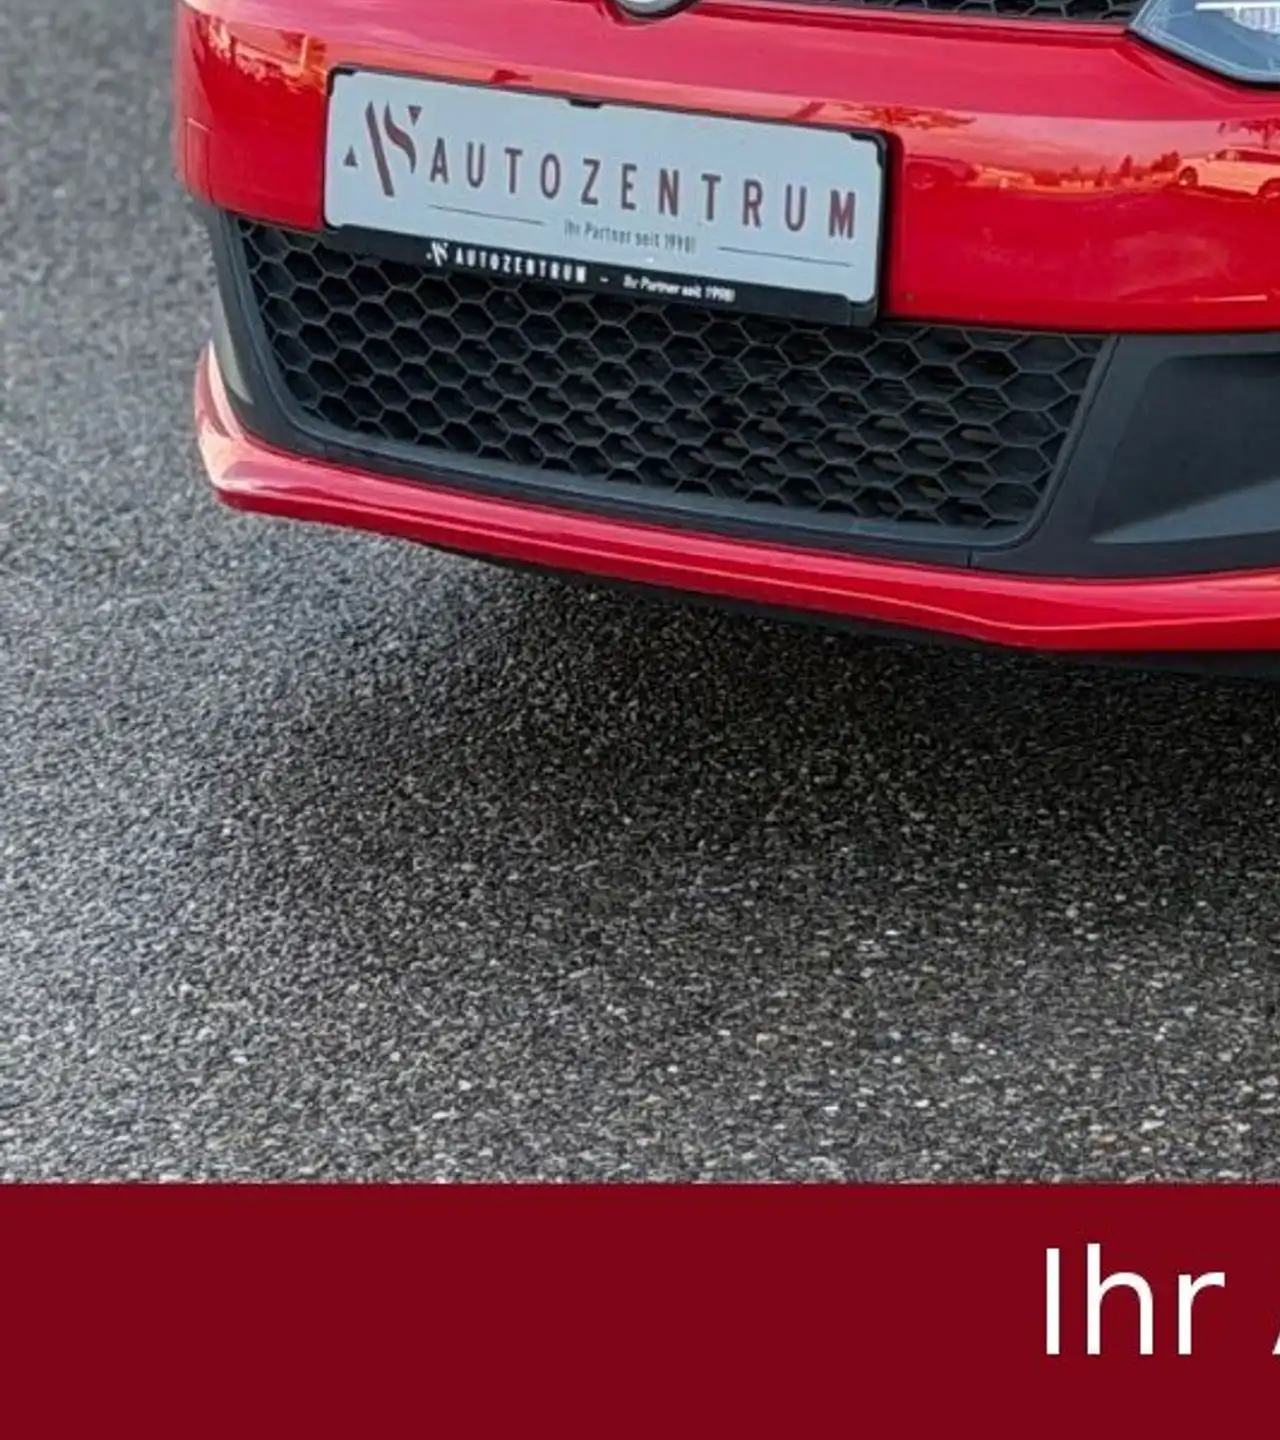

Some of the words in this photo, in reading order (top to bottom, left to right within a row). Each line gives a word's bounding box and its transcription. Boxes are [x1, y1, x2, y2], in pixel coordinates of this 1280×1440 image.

[429, 137, 857, 240] AUTOZENTRUM
[584, 221, 632, 244] Partner
[634, 231, 660, 249] seit
[455, 247, 587, 284] AUTOZENTRUM
[640, 275, 681, 295] Partner
